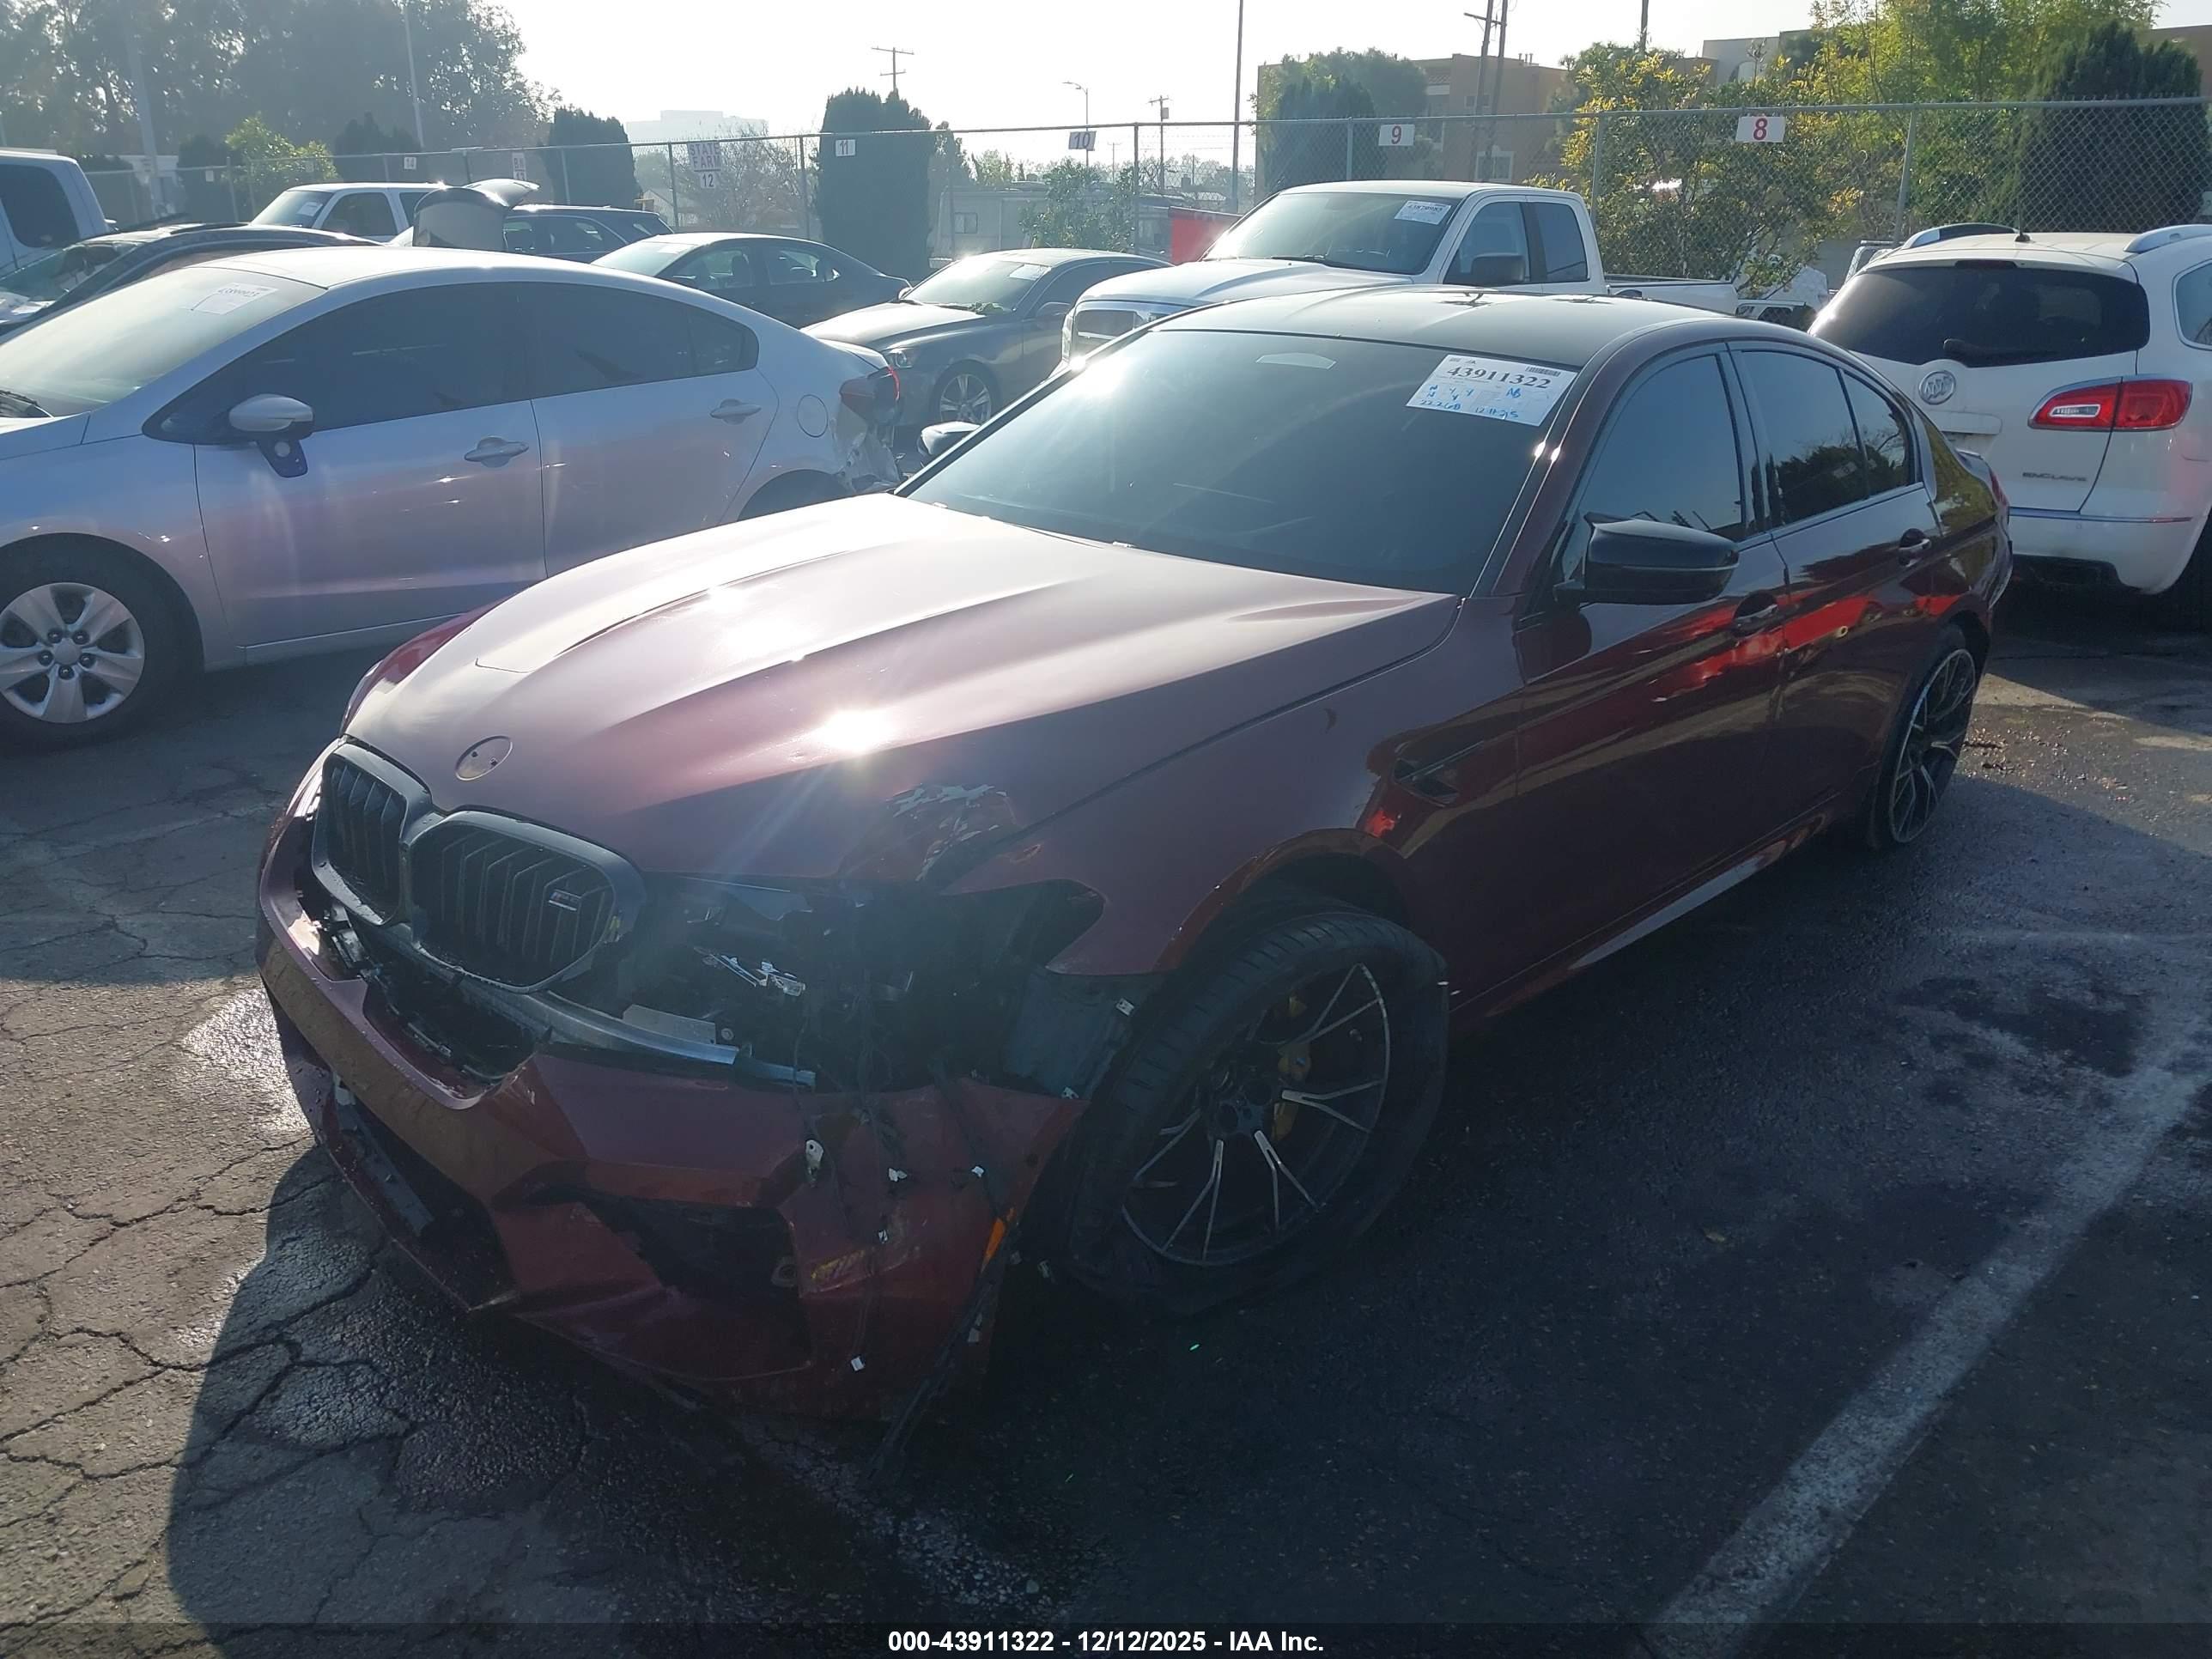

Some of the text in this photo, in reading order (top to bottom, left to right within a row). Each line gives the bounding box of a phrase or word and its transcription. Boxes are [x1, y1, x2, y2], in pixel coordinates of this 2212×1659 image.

[1391, 125, 1402, 145] 9
[1753, 118, 1768, 141] 8
[839, 140, 848, 155] 11
[1074, 131, 1091, 149] 10
[690, 143, 720, 155] STATE
[692, 155, 720, 168] FARM
[702, 173, 714, 187] 12
[1447, 366, 1552, 389] 43911322
